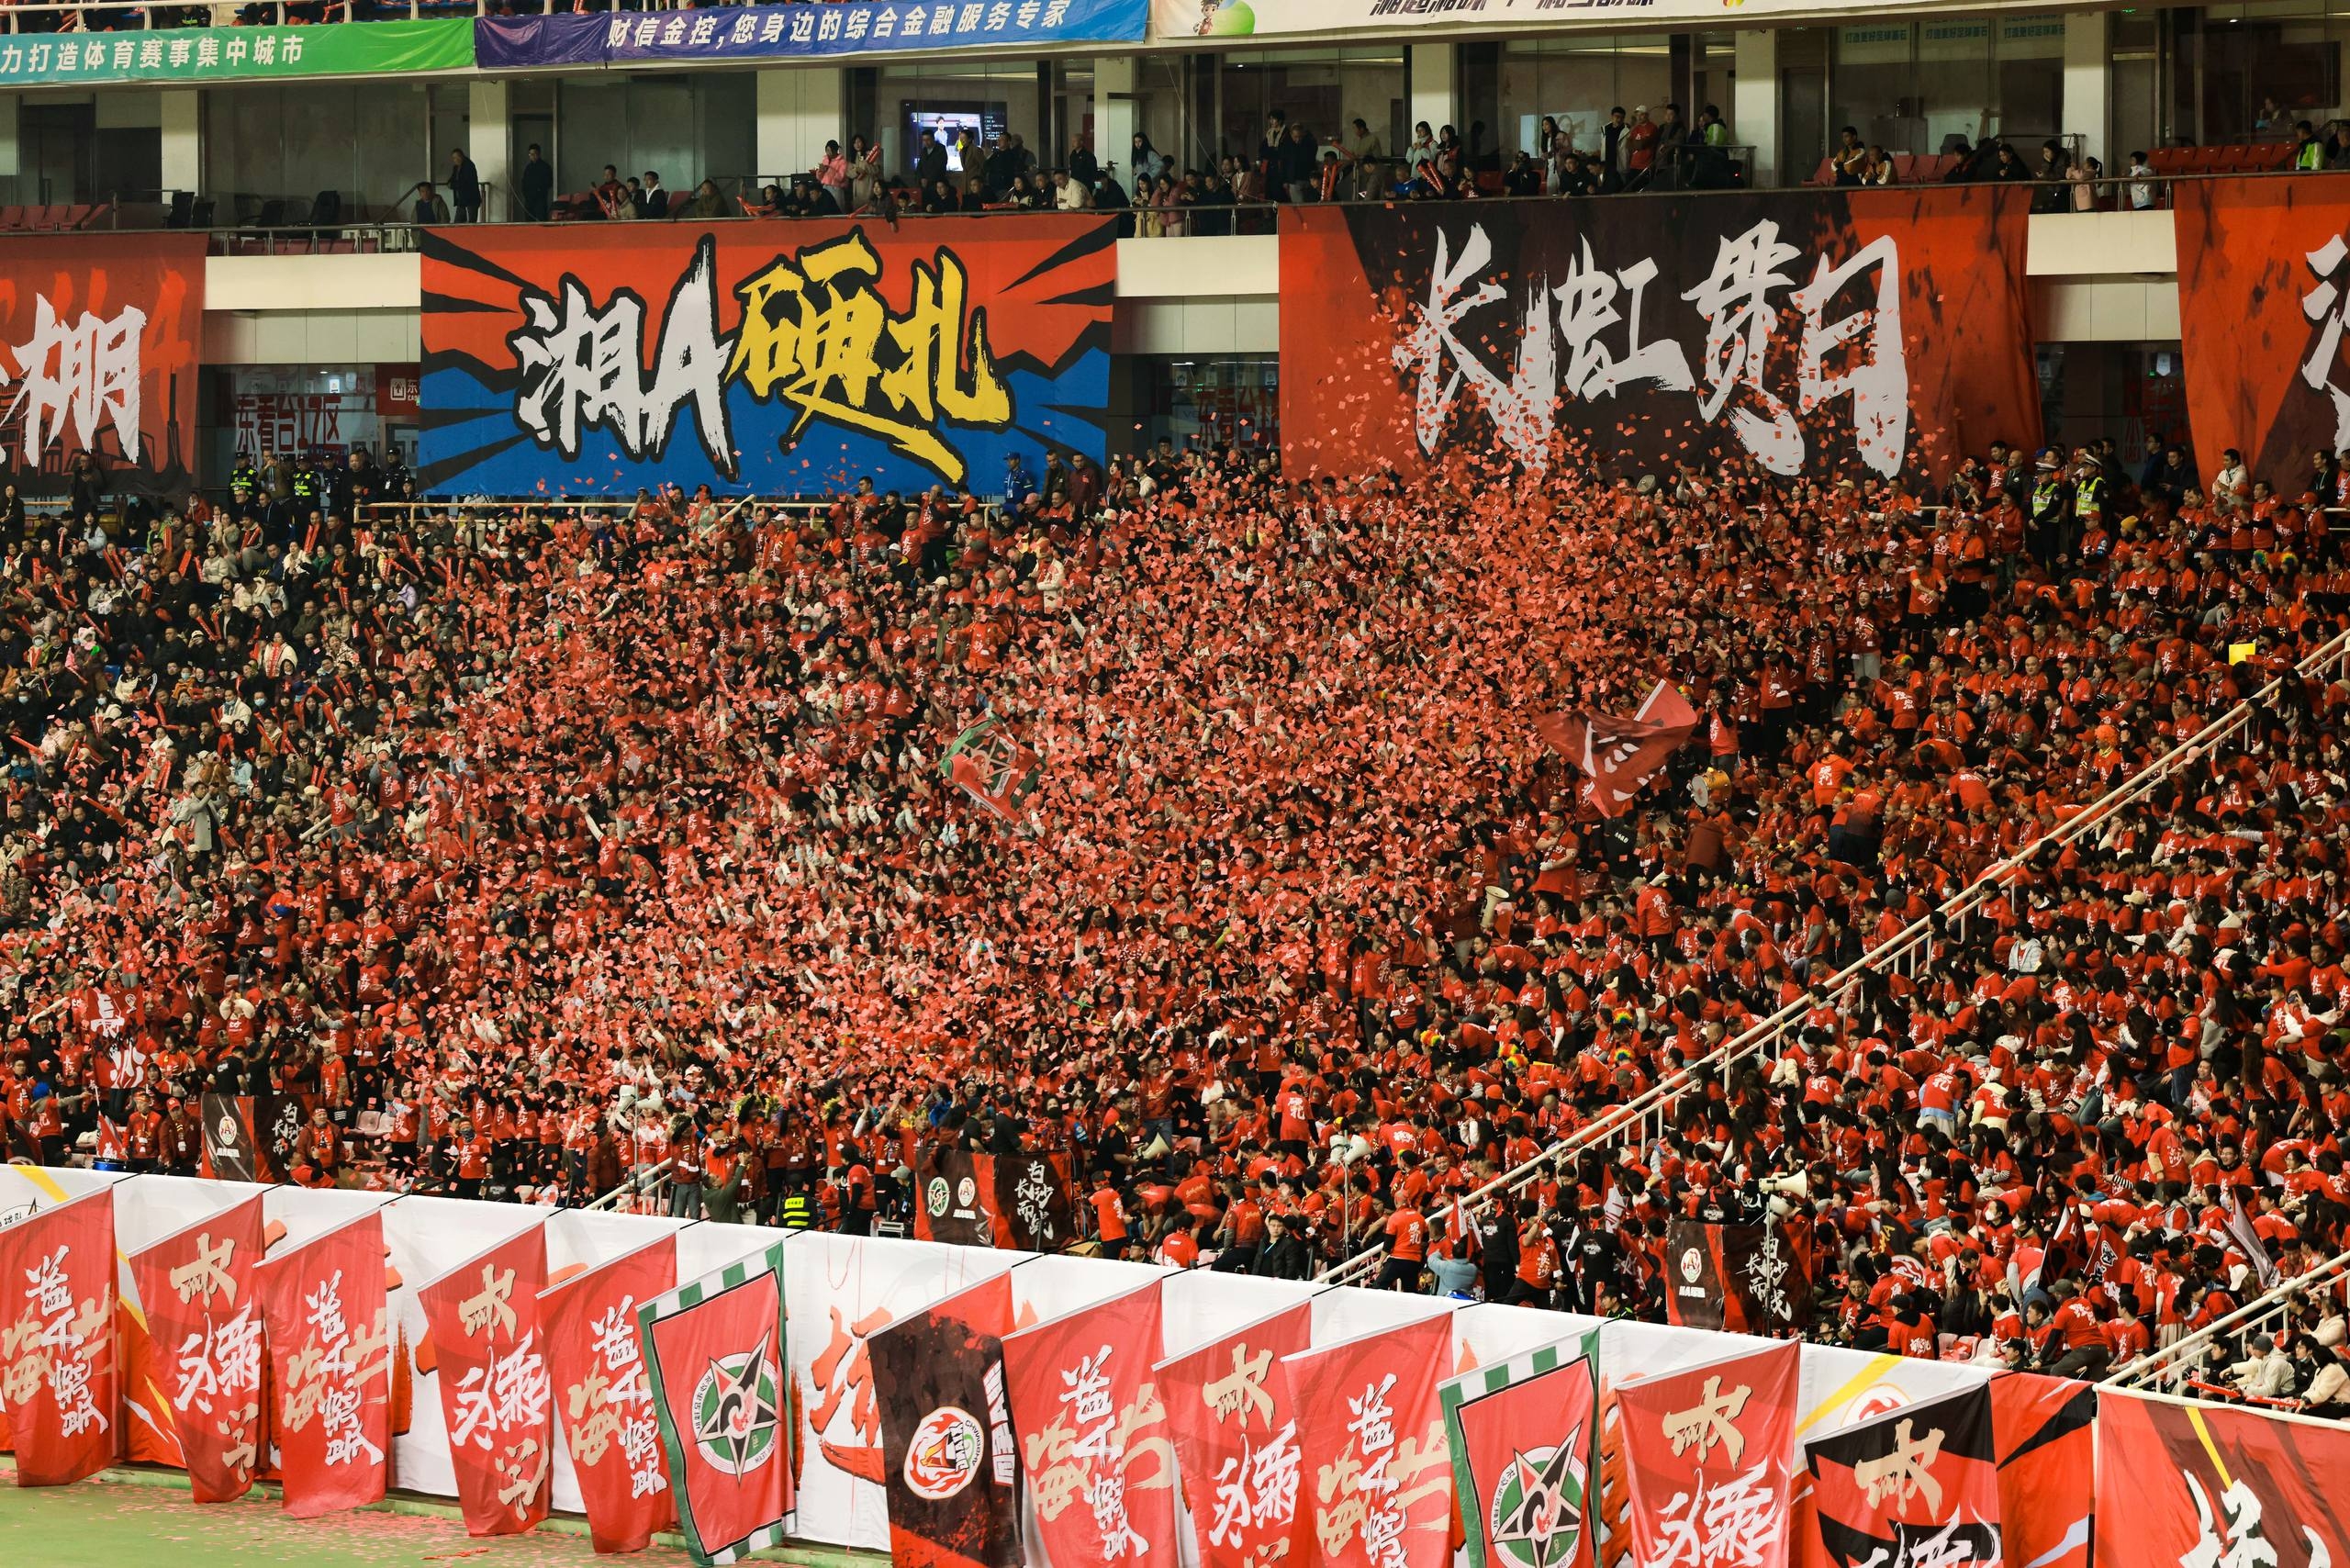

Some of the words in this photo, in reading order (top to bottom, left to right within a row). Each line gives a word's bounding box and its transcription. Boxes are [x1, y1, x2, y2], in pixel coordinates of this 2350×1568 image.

[0, 35, 305, 74] 力打造体育赛事集中城市
